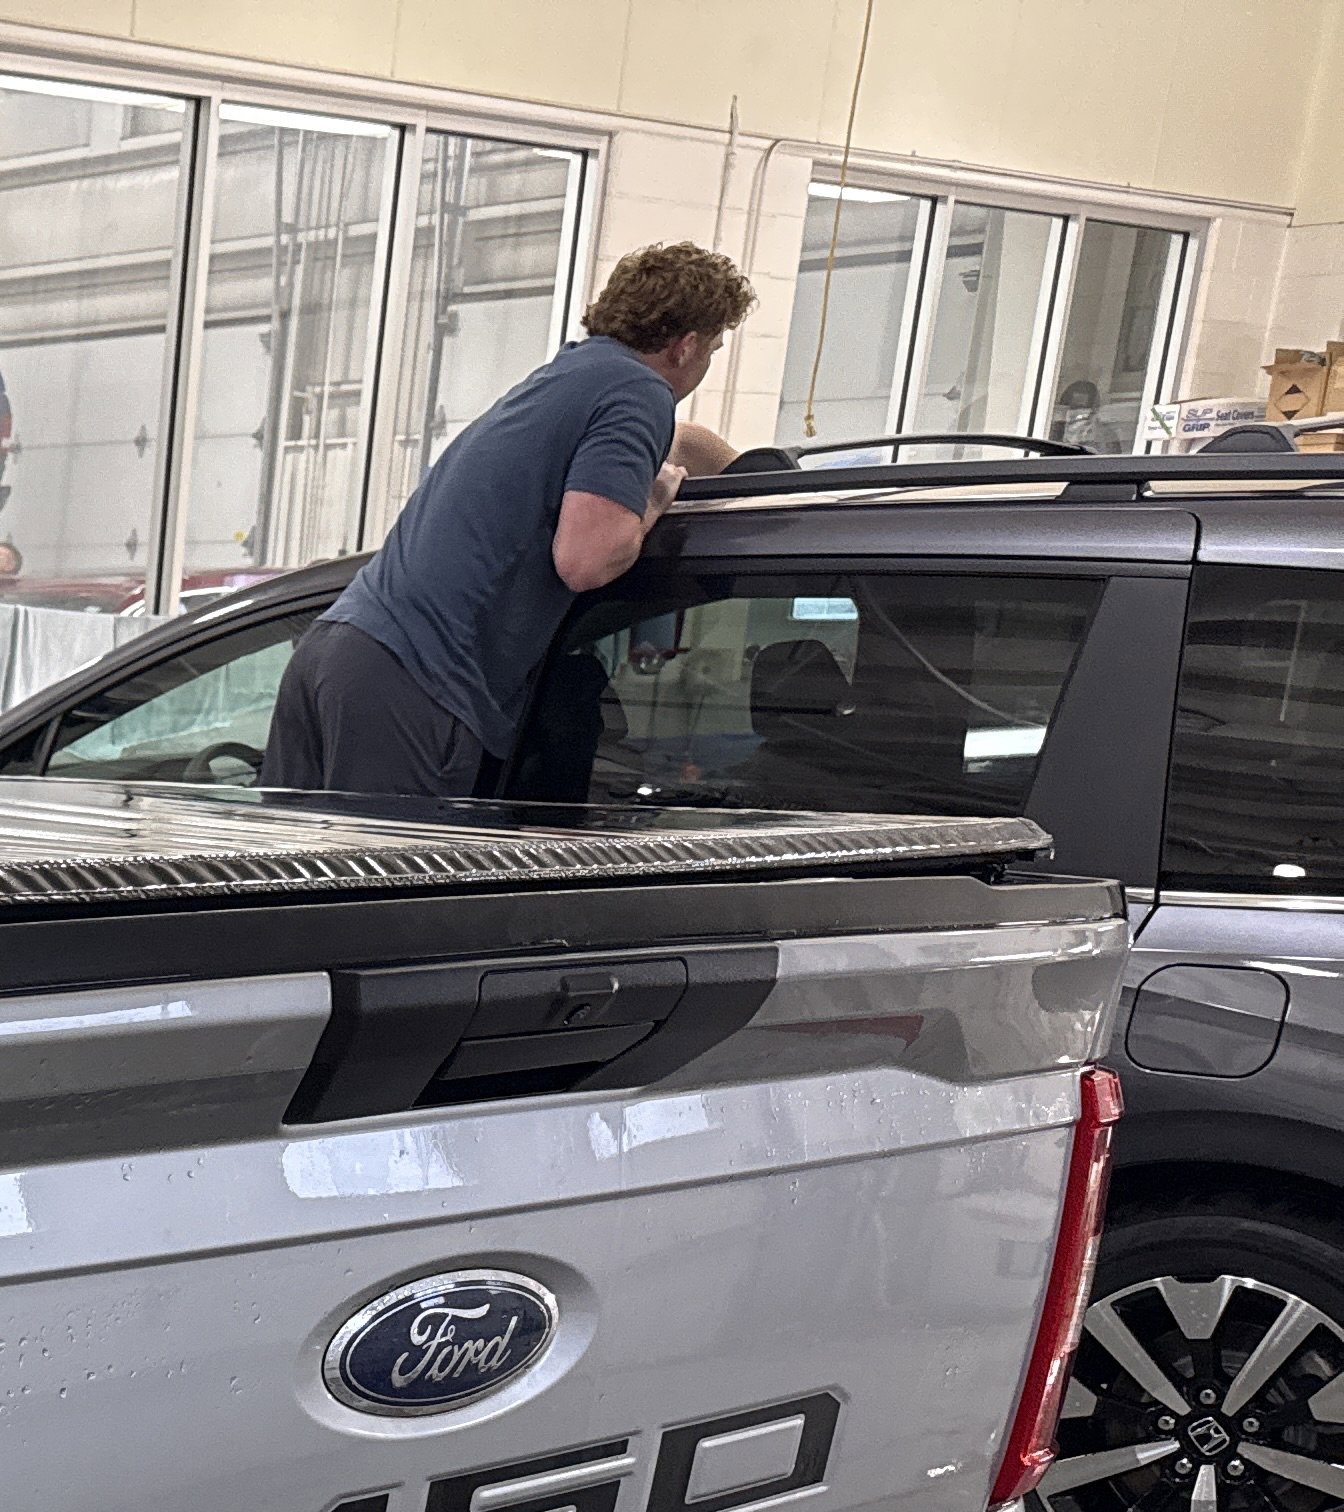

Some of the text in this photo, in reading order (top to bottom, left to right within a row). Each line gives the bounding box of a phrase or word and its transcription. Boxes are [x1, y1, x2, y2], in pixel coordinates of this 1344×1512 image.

[1216, 409, 1255, 421] Seat Covers
[1182, 422, 1211, 433] GRIP
[391, 1302, 519, 1388] Ford
